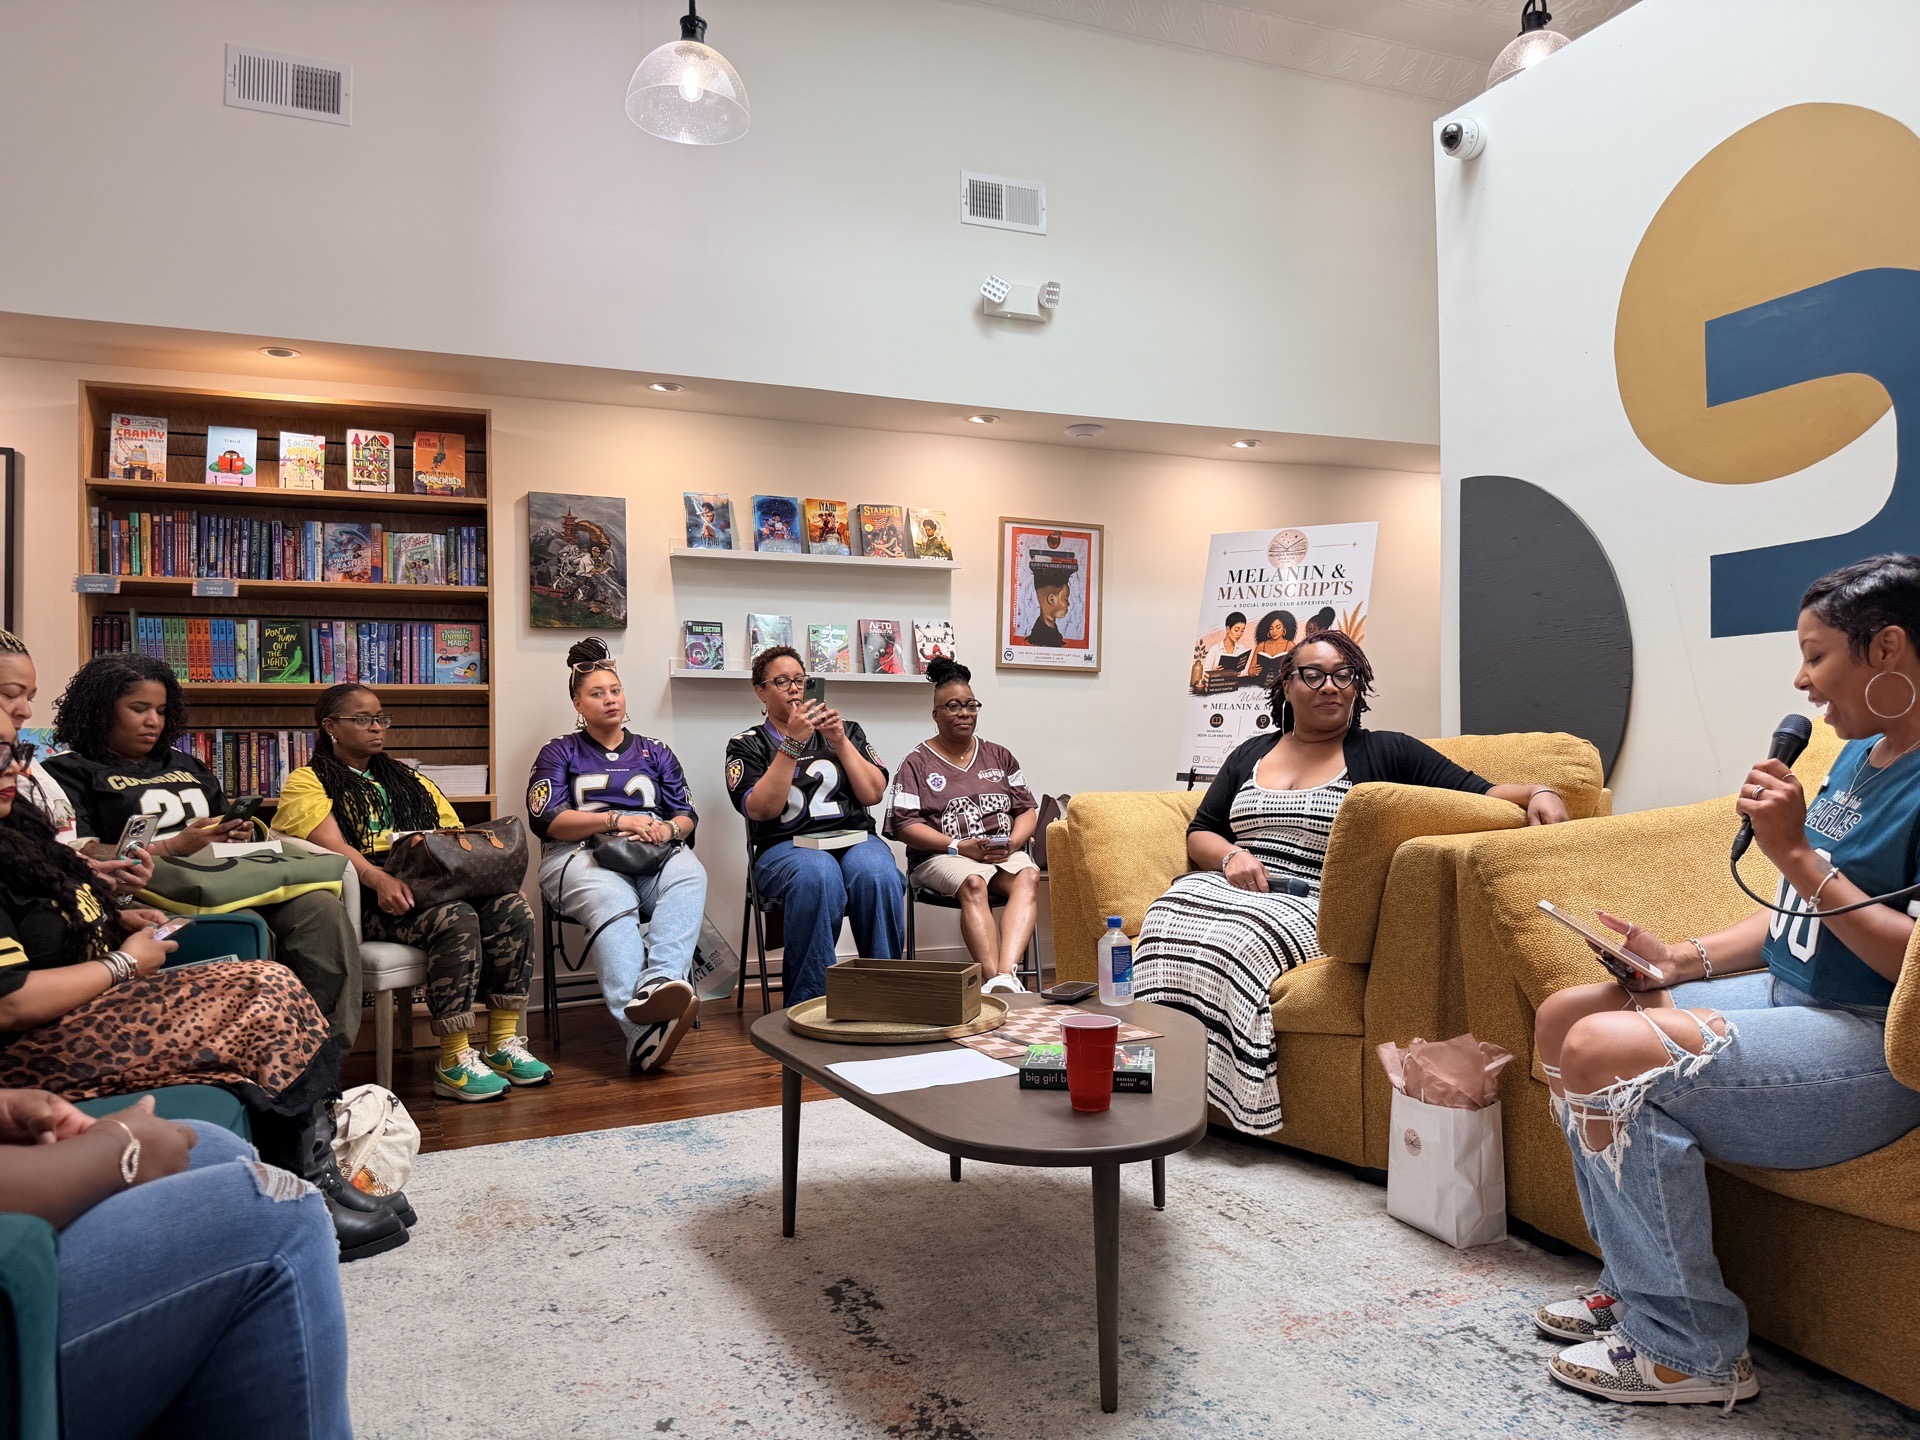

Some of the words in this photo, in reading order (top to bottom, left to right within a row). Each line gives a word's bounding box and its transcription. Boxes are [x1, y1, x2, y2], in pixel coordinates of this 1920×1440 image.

[116, 428, 166, 440] CRANKY
[355, 469, 388, 481] KEYS
[418, 474, 462, 486] SUSPENDED
[864, 506, 899, 517] STAMPED
[328, 556, 354, 564] KWAME
[1226, 565, 1325, 584] MELANIN
[1332, 564, 1346, 578] &
[1218, 581, 1353, 600] MANUSCRIPTS
[265, 627, 290, 637] DON'T
[277, 634, 297, 642] TURN
[262, 657, 288, 668] LIGHTS
[1239, 691, 1264, 702] Welc
[1805, 798, 1862, 841] EAGLES
[708, 950, 718, 958] LOVE
[1025, 1072, 1040, 1084] big
[1042, 1073, 1058, 1084] girl
